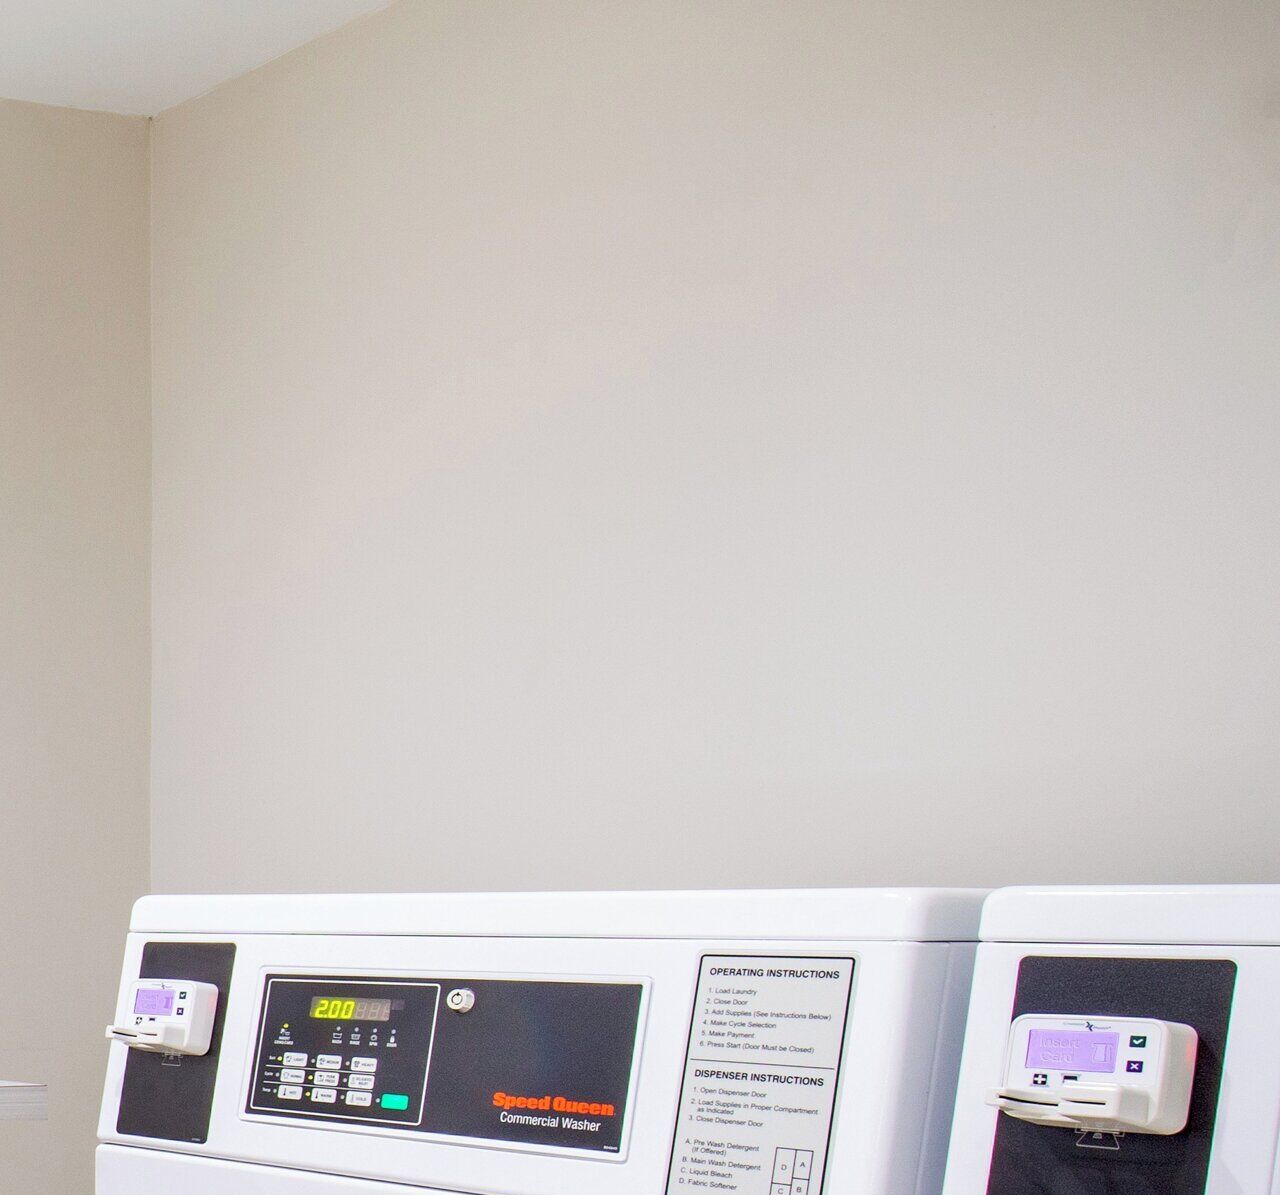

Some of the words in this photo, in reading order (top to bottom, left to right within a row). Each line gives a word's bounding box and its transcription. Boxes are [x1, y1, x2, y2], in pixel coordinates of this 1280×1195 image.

[710, 968, 763, 976] OPERATING
[767, 969, 839, 979] INSTRUCTIONS
[789, 1046, 814, 1054] Closed)
[695, 1070, 748, 1080] DISPENSER
[750, 1074, 824, 1086] INSTRUCTIONS
[493, 1092, 551, 1110] Speed
[553, 1097, 614, 1116] Queen
[500, 1112, 558, 1127] Commercial
[561, 1118, 601, 1131] Washer
[715, 1117, 746, 1125] Dispenser
